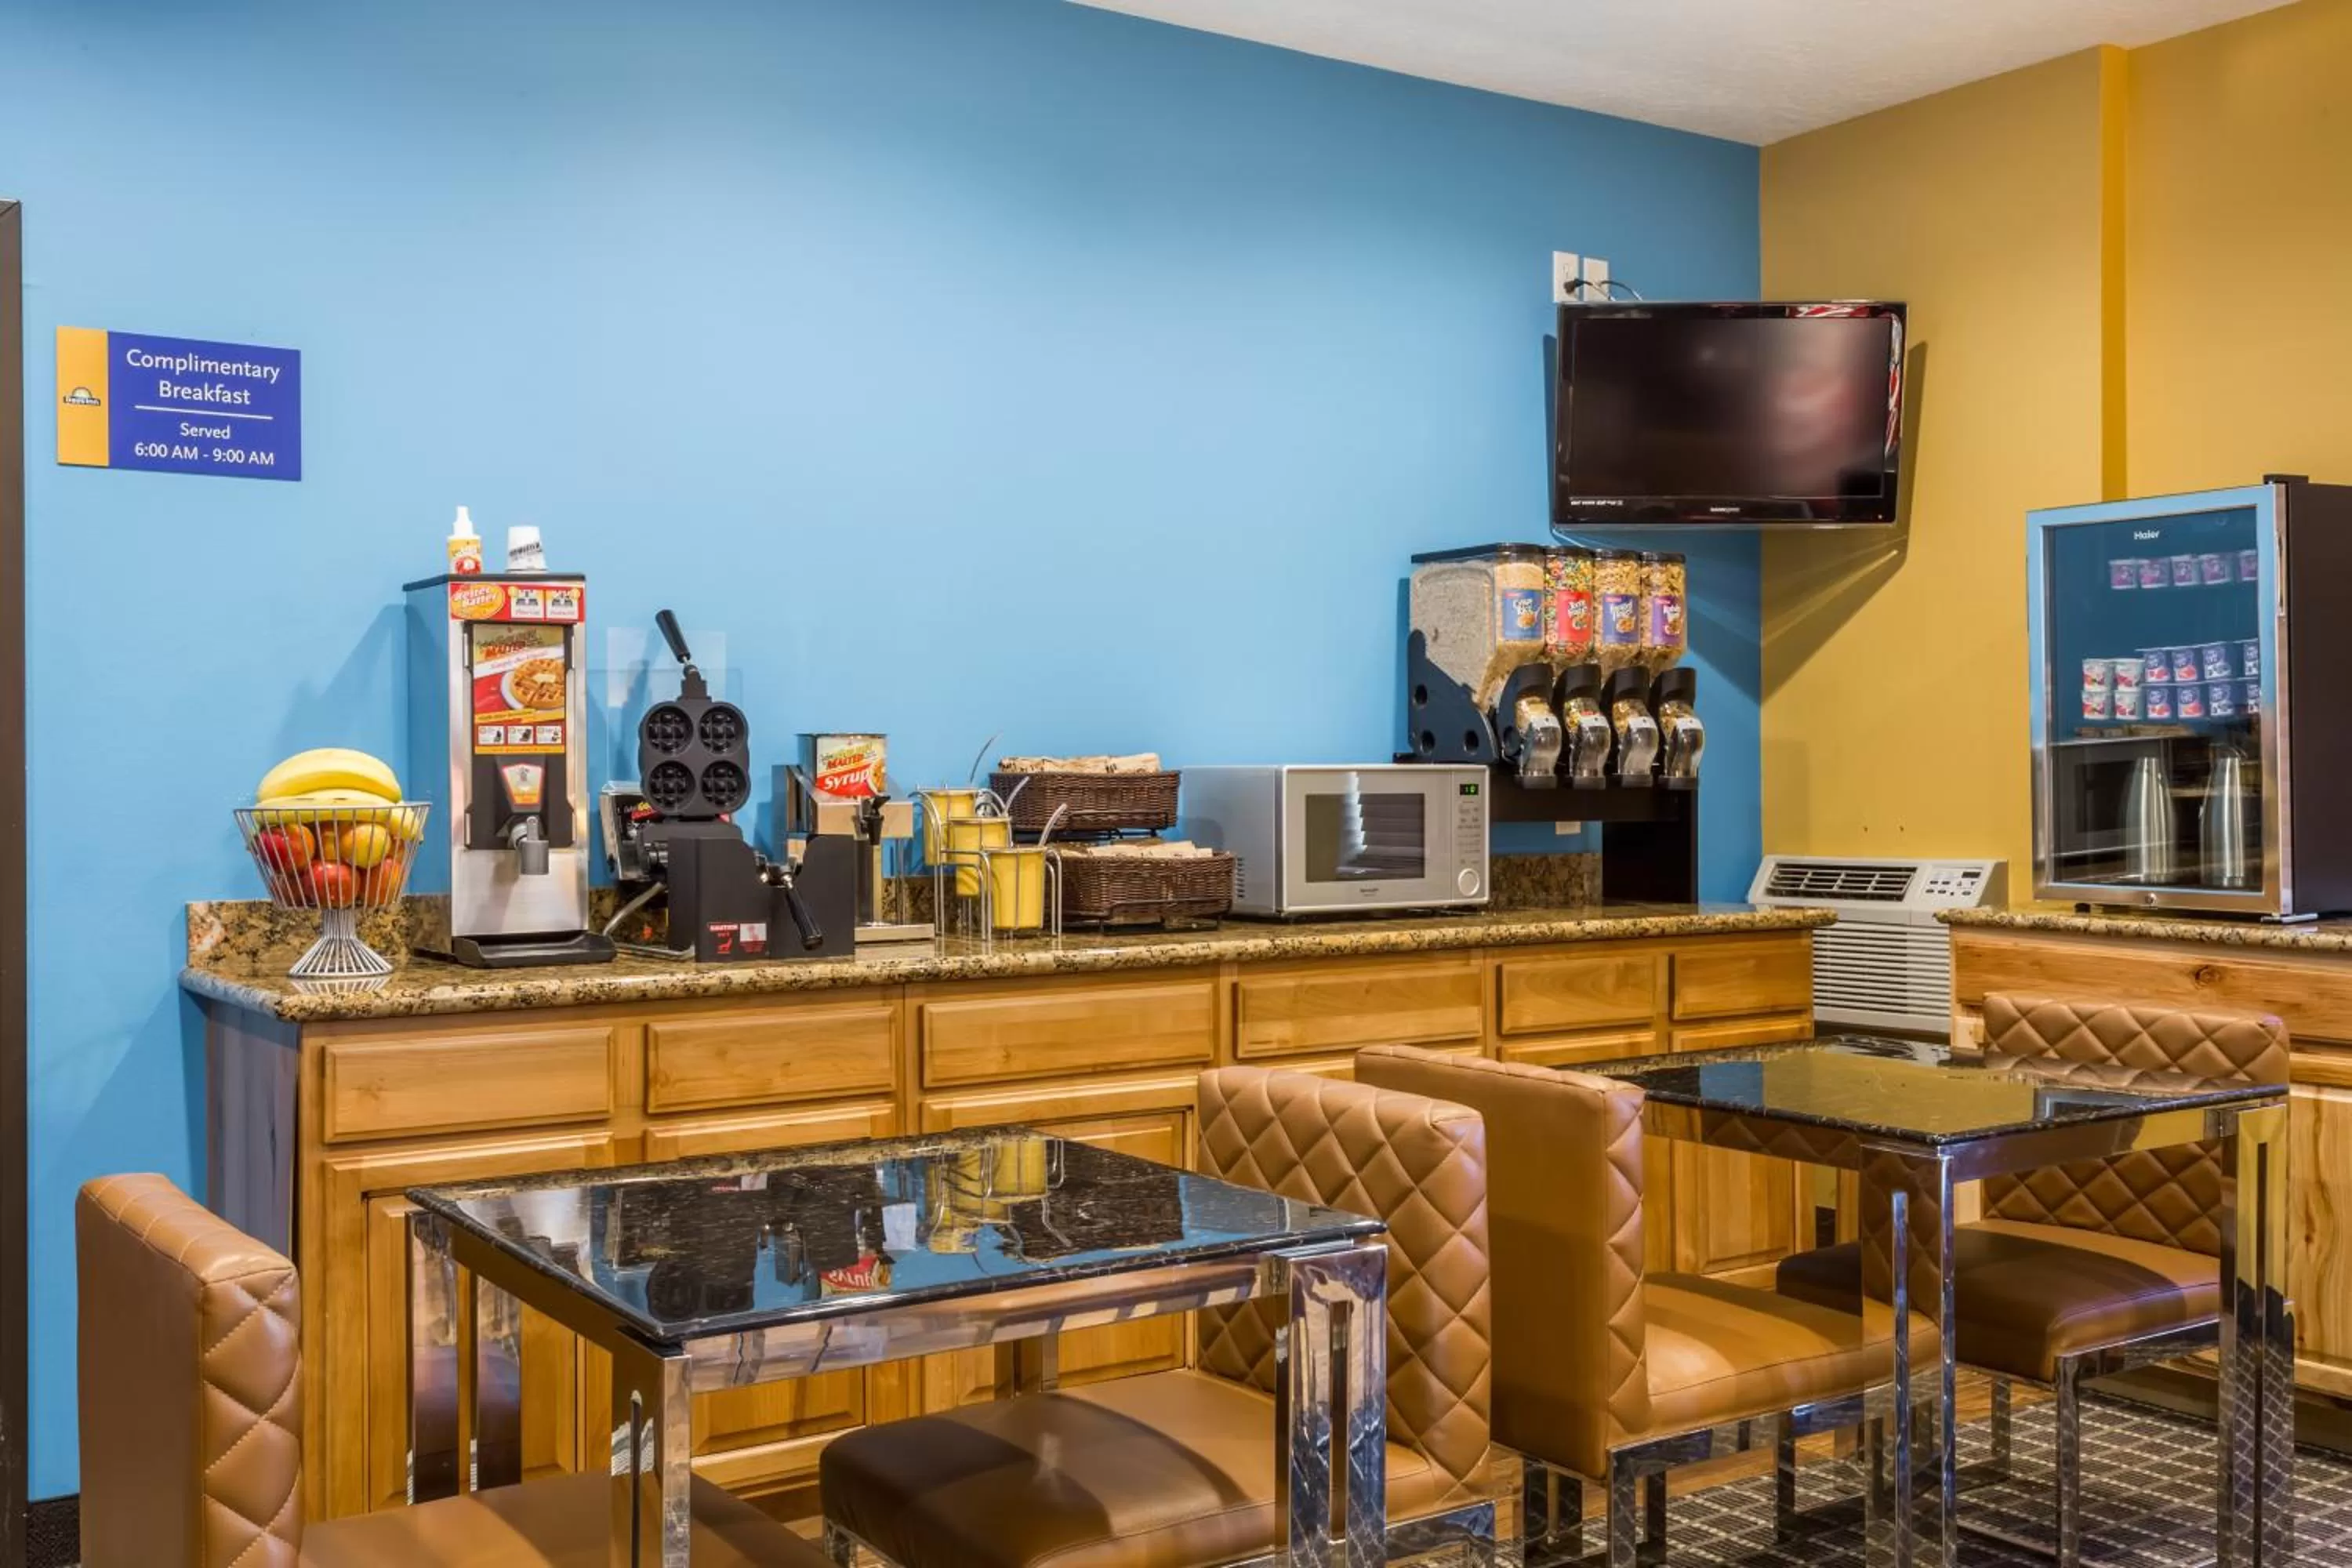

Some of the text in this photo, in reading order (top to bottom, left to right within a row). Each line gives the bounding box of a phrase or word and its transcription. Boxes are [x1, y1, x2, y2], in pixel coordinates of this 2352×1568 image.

[126, 349, 280, 384] Complimentary
[159, 380, 251, 405] Breakfast
[180, 423, 230, 440] Served
[135, 442, 168, 459] 6:00
[172, 445, 198, 461] AM
[212, 448, 245, 463] 9:00
[249, 450, 274, 465] AM
[2133, 529, 2161, 540] Haier
[824, 768, 870, 789] Syrup
